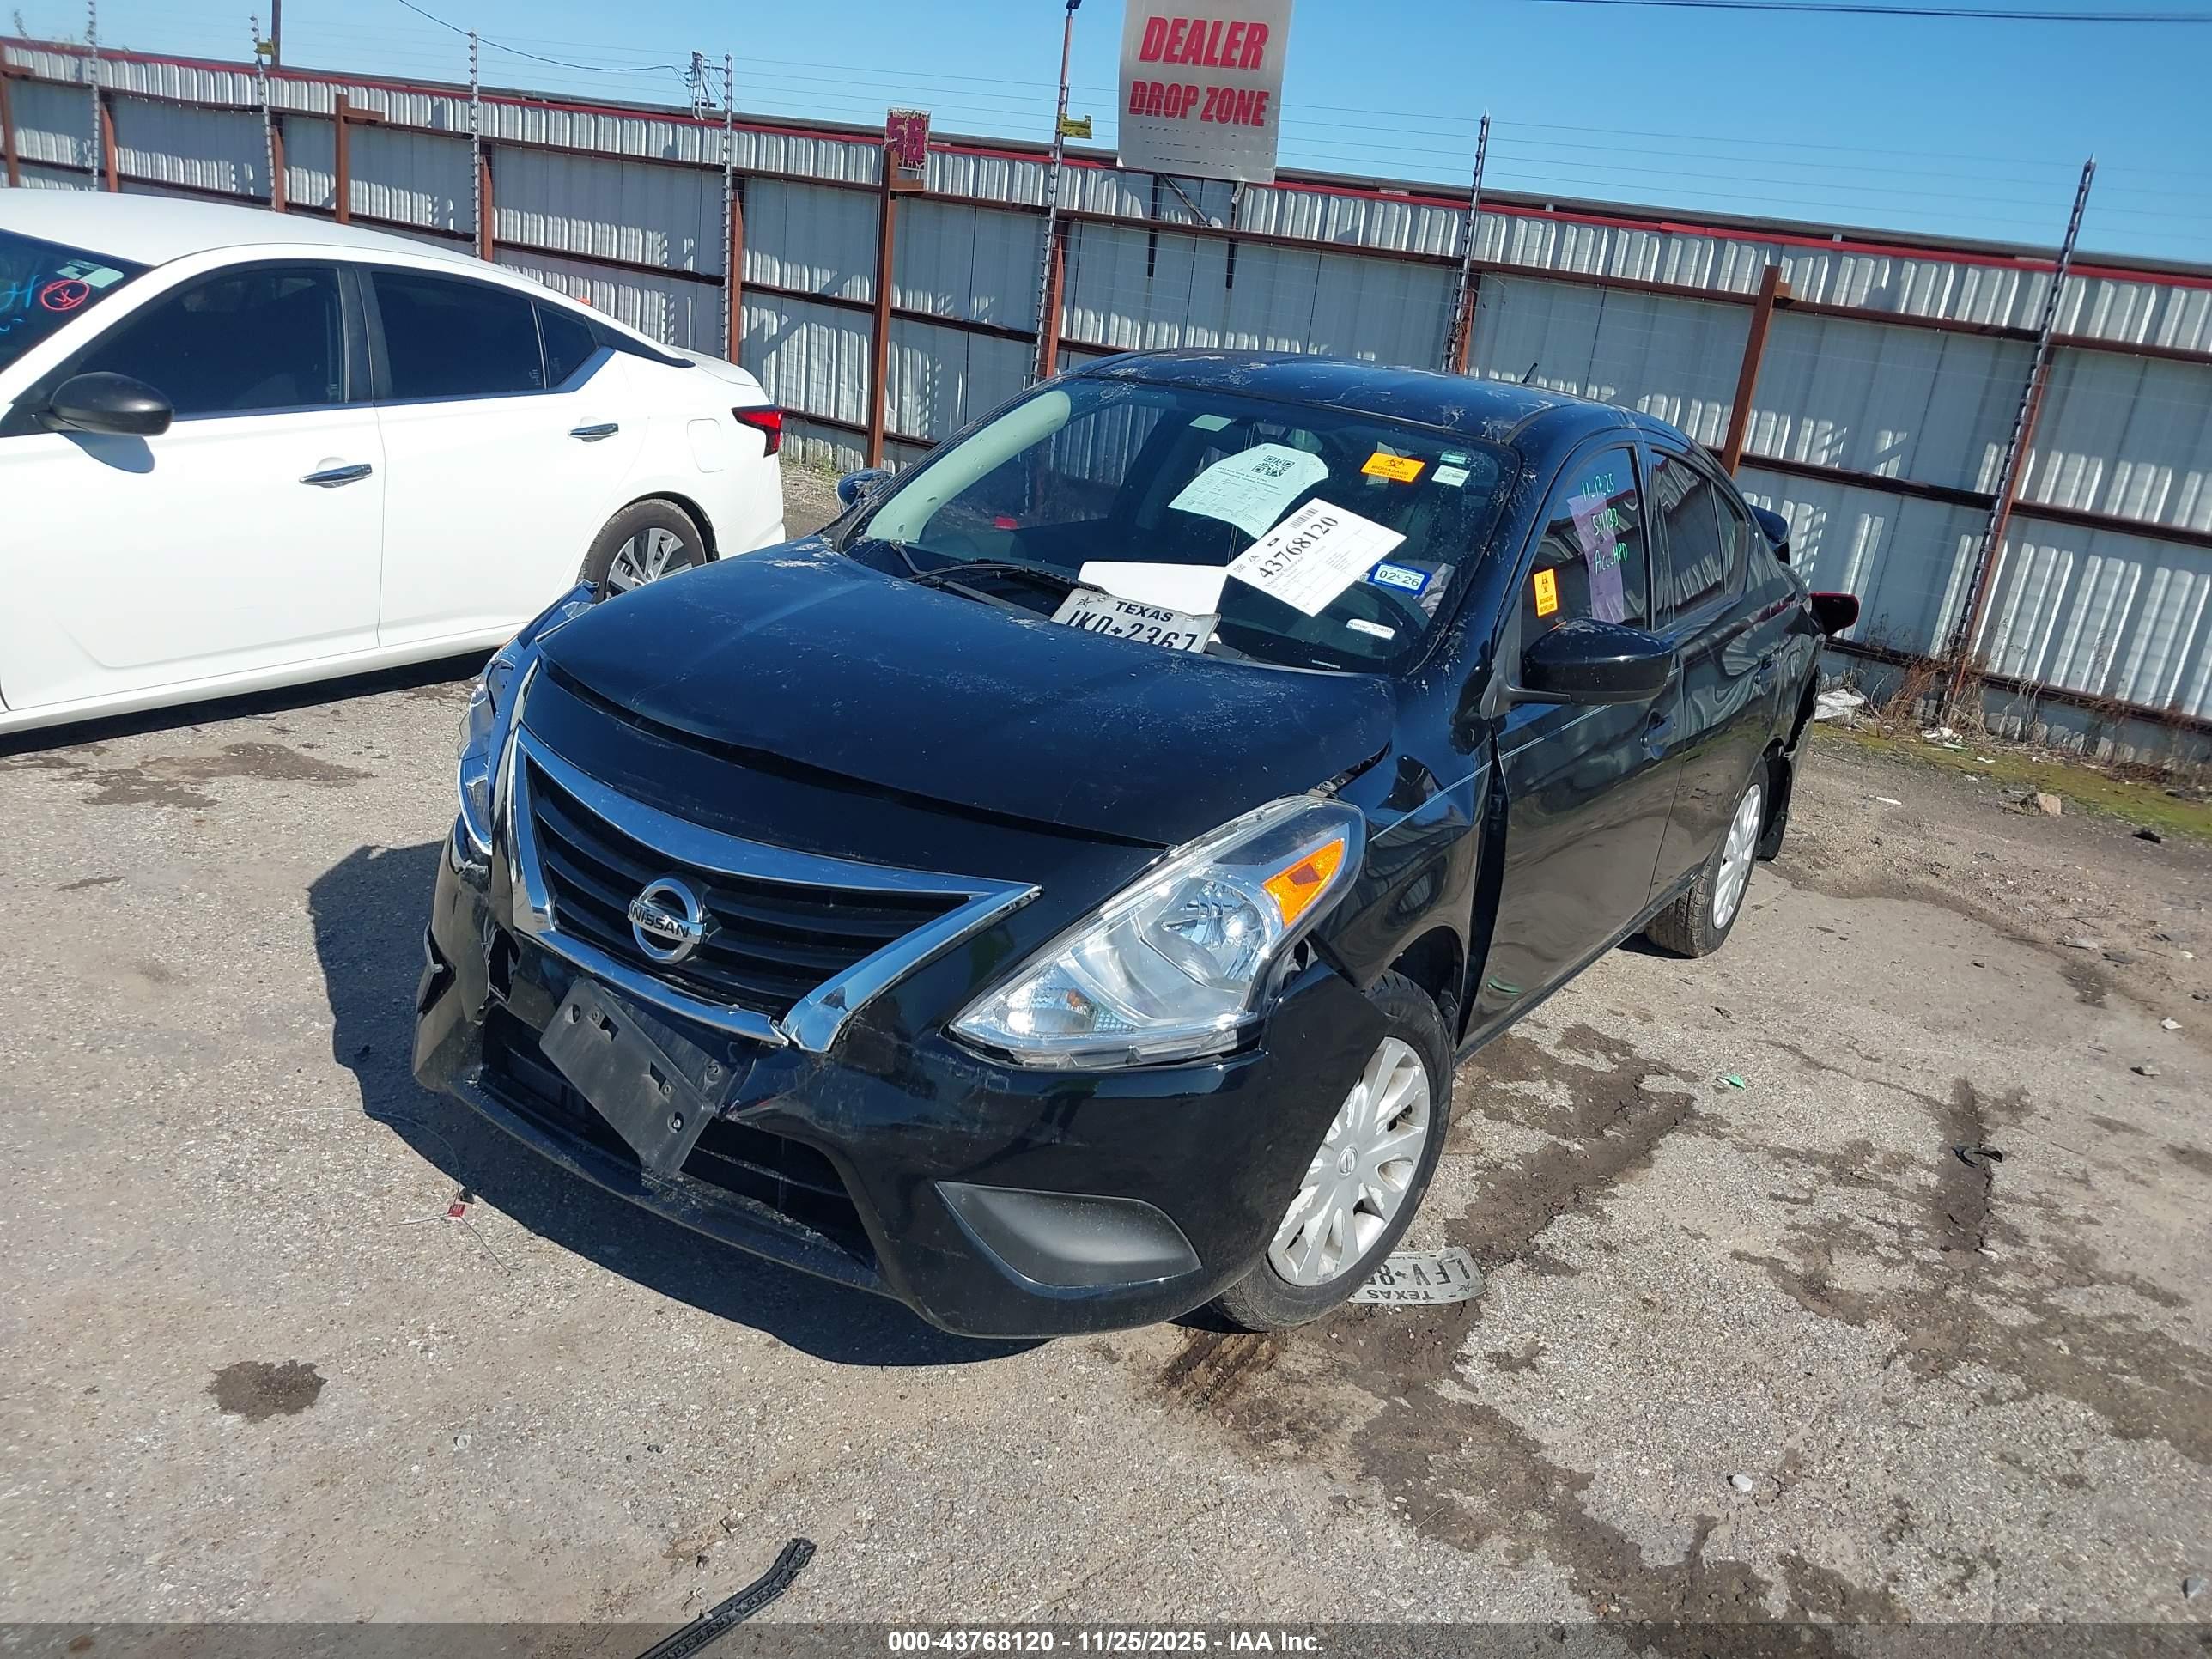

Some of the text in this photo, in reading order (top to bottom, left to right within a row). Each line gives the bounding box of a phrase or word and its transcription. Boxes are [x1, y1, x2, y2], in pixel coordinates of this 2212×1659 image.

[1139, 16, 1269, 70] DEALER
[1129, 80, 1271, 126] DROP ZONE
[1258, 516, 1339, 579] 43768120
[1402, 576, 1420, 587] 26
[1115, 601, 1174, 622] TEXAS
[632, 907, 690, 938] NISSAN
[1367, 1289, 1435, 1301] TEXAS
